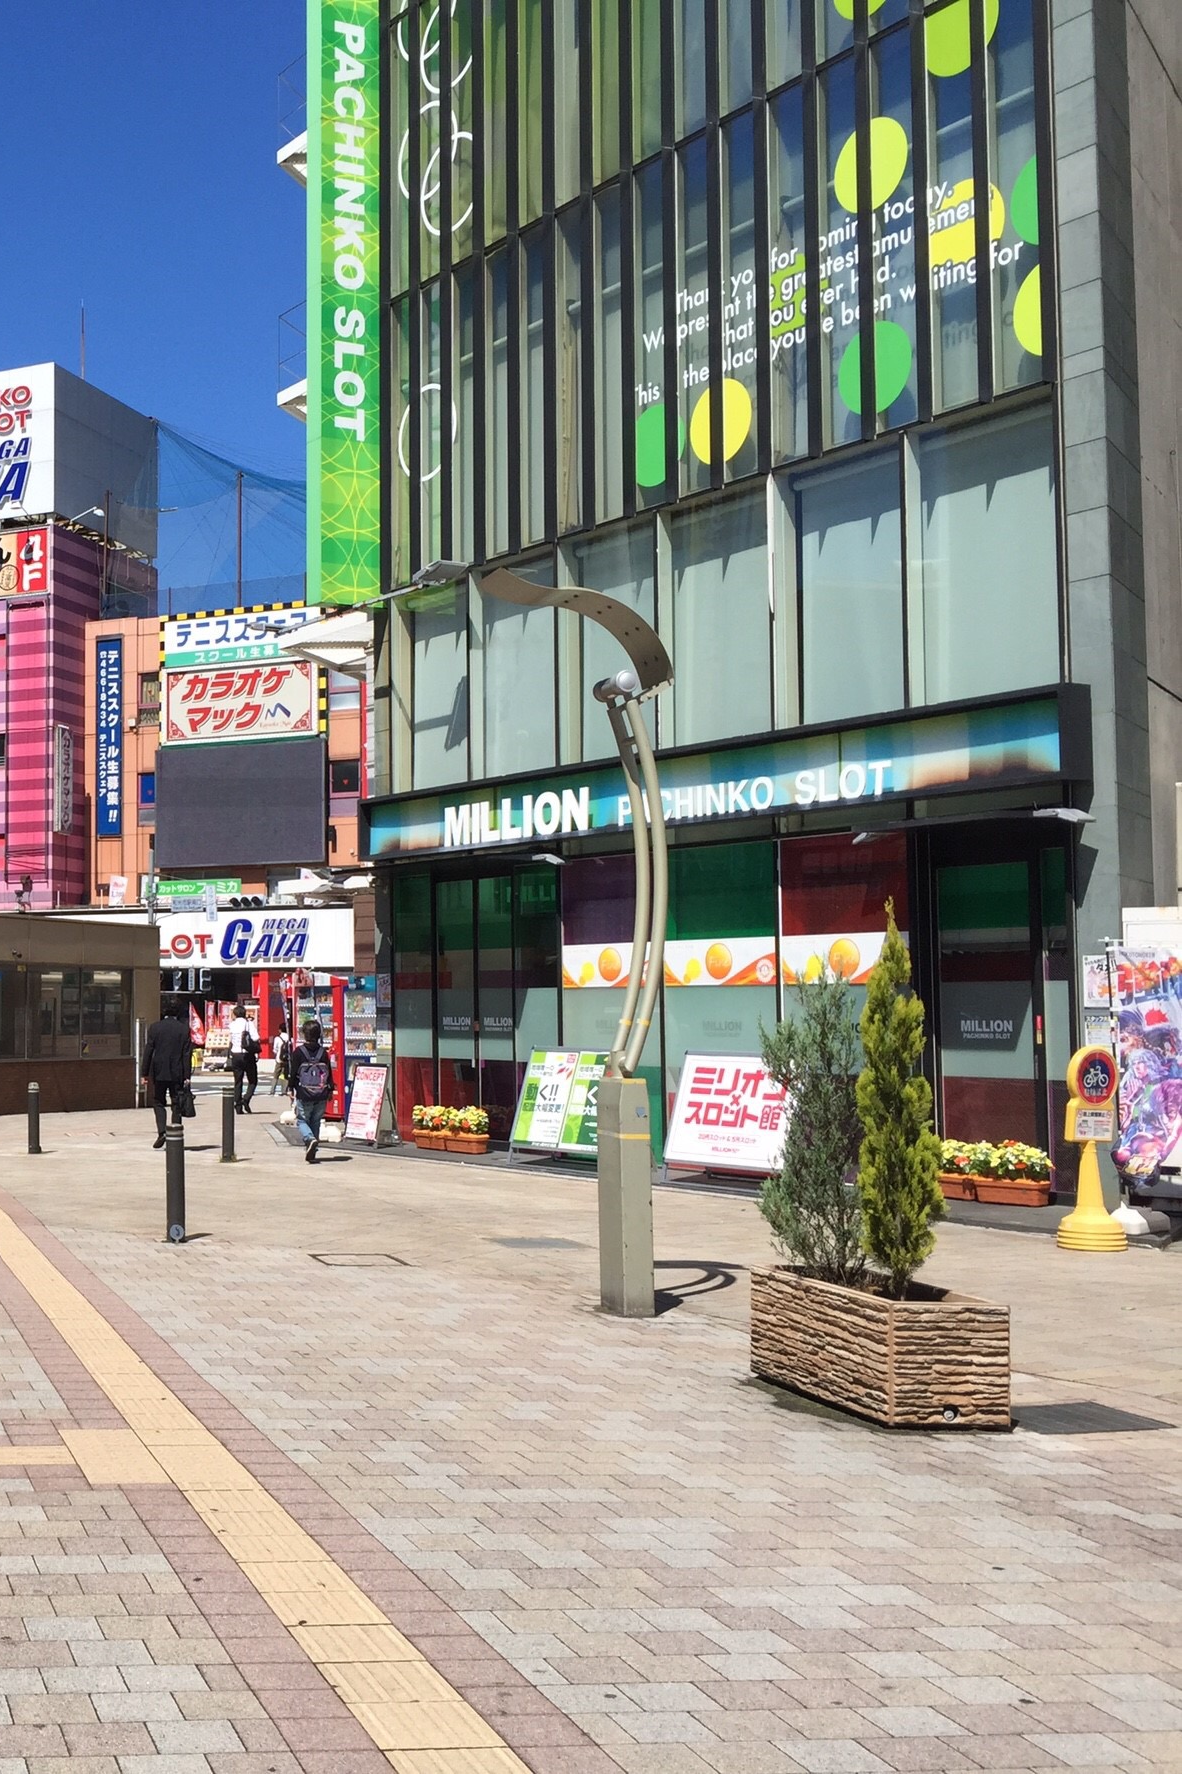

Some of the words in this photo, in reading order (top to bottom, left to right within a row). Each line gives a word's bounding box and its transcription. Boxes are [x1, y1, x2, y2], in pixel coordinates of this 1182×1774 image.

[333, 19, 366, 291] PACHINKO
[731, 269, 754, 298] yo
[771, 246, 798, 273] for
[683, 363, 710, 389] the
[900, 258, 977, 303] witing
[990, 240, 1024, 270] for
[722, 317, 754, 346] hat
[770, 302, 794, 327] ou
[851, 255, 897, 294] hd.
[333, 305, 366, 442] SLOT
[20, 535, 44, 591] 4F
[181, 667, 292, 702] カラオケ
[186, 701, 263, 733] マック
[444, 787, 590, 847] MILLION
[794, 759, 893, 806] SLOT
[158, 883, 196, 893] カットサロン
[196, 881, 238, 894] フミカ
[220, 918, 308, 960] GAIA
[262, 917, 308, 930] MEGA
[442, 1016, 471, 1026] MILLION
[483, 1016, 513, 1027] MILLION
[702, 1020, 742, 1031] MILLION
[960, 1019, 1013, 1032] MILLION
[684, 1101, 784, 1131] スロット館
